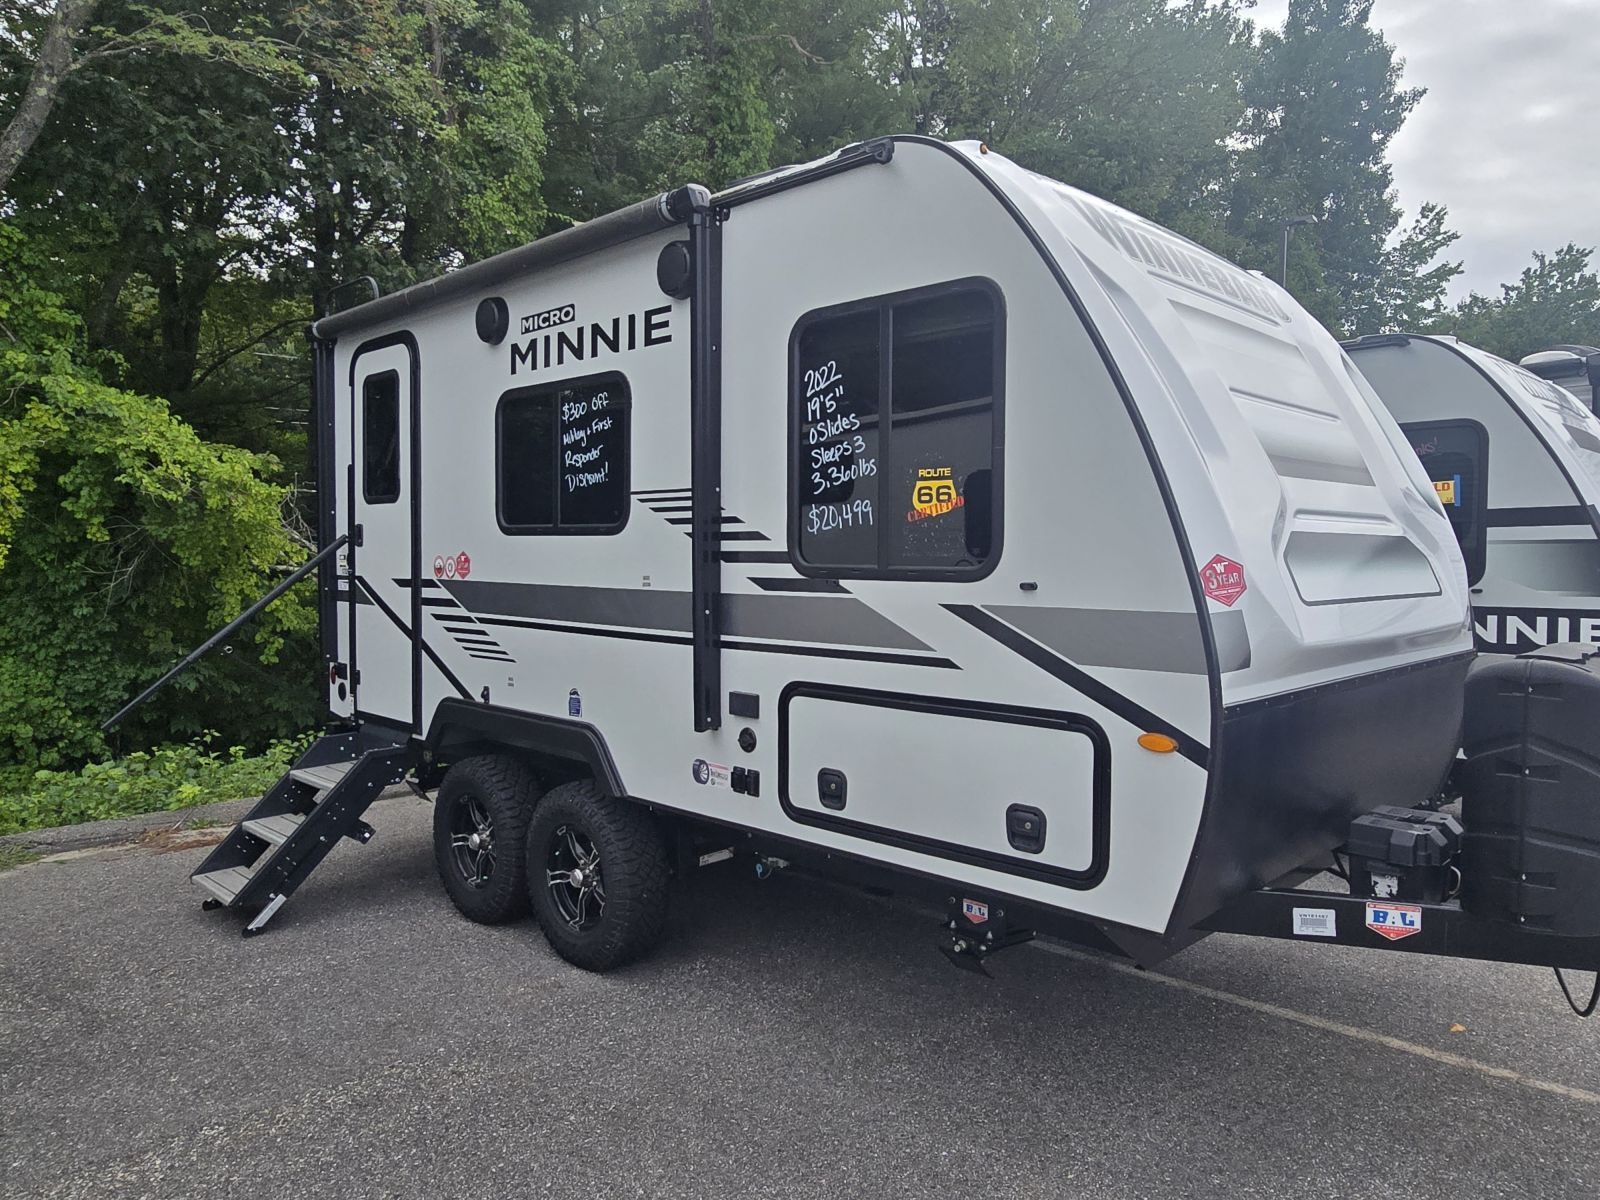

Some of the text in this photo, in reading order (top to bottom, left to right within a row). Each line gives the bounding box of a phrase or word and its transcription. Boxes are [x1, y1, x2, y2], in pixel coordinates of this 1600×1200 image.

[521, 305, 575, 334] MICRO
[510, 304, 673, 375] MINNIE
[804, 360, 842, 397] 2022
[562, 402, 588, 424] $300
[592, 416, 613, 433] First
[853, 435, 866, 453] 3
[918, 467, 952, 478] ROUTE
[917, 485, 952, 504] 66
[807, 499, 874, 535] $20,499
[907, 495, 965, 522] CERTIFIED
[1205, 569, 1240, 590] 3 YEAR
